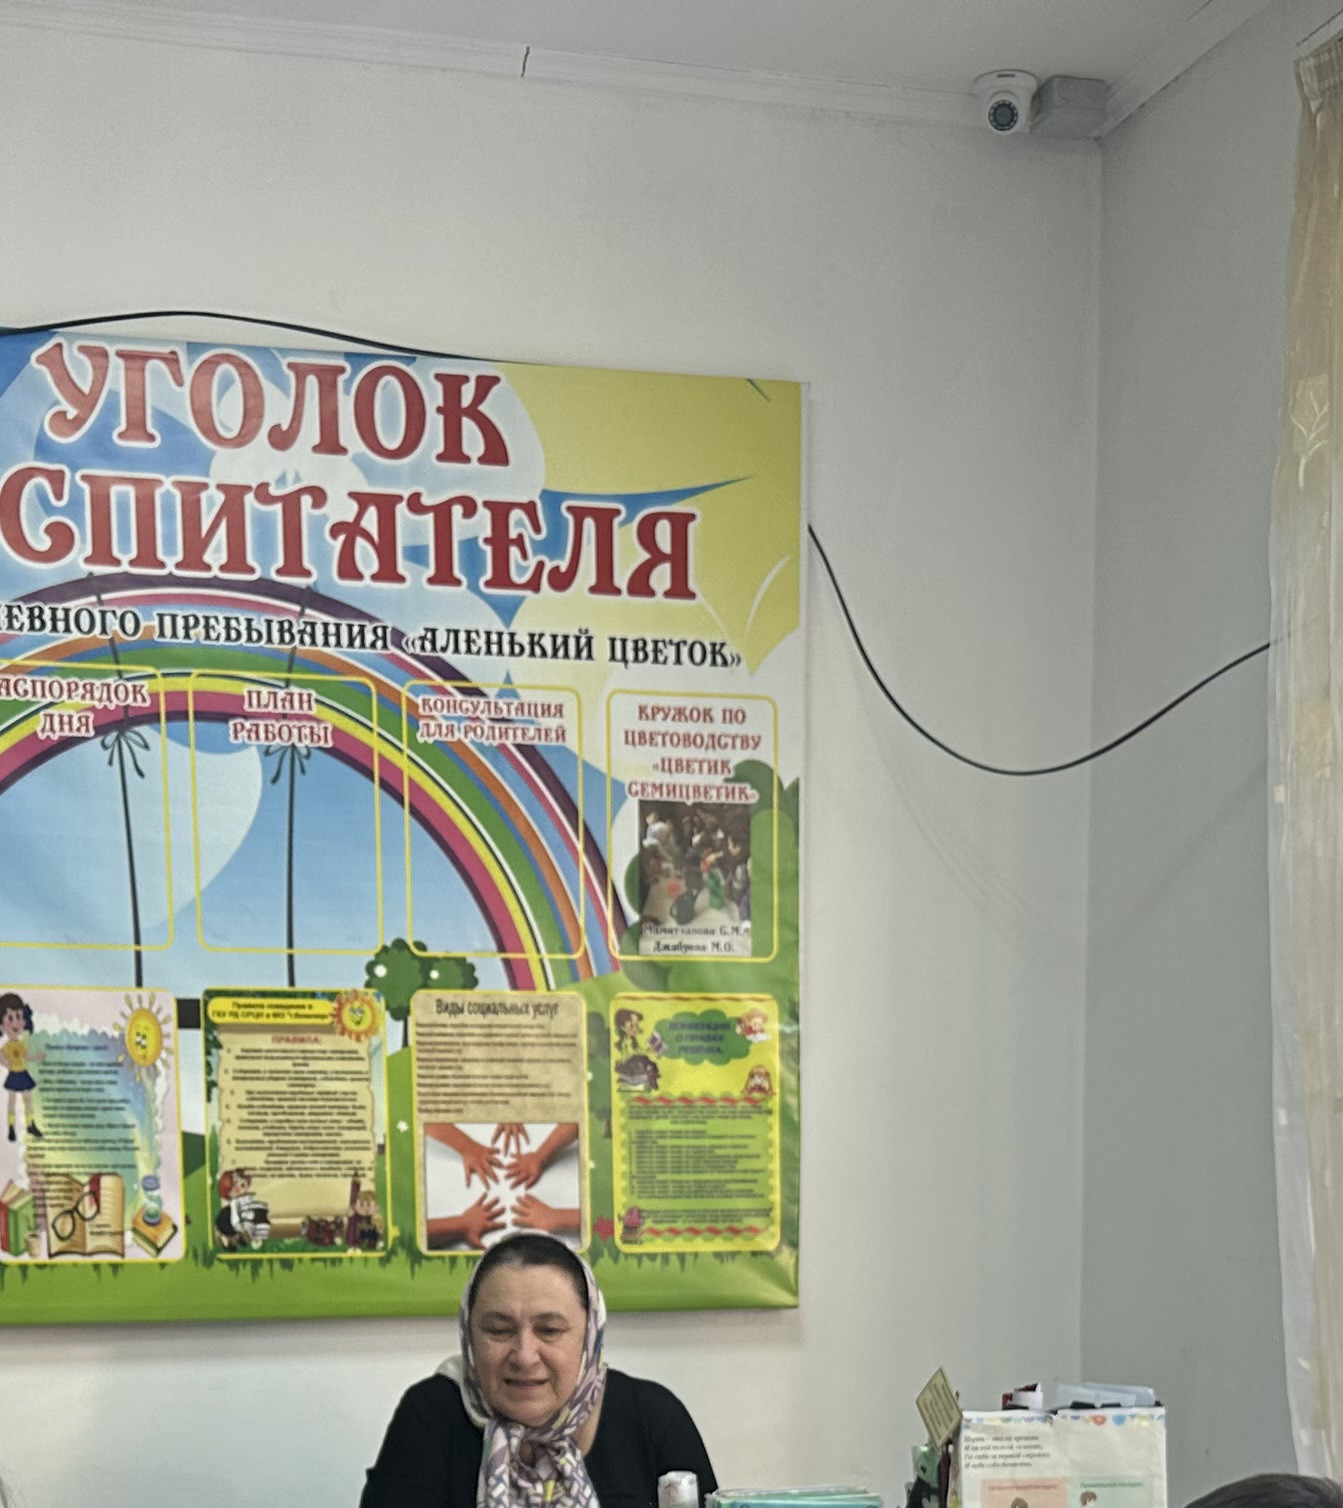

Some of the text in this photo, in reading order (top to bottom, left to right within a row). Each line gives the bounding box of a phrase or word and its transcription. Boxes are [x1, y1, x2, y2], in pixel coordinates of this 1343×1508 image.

[38, 341, 511, 466] УГОЛОК
[157, 613, 389, 651] ПРЕБЫВАНИЯ
[402, 627, 594, 662] «АЛЕНЬКИЙ
[608, 638, 742, 670] ЦВЕТОК»
[244, 690, 315, 712] ПЛАН
[421, 697, 564, 719] КОНСУЛЬТАЦИЯ
[38, 711, 94, 738] ДНЯ
[637, 704, 747, 725] КРУЖОК ПО
[231, 721, 332, 746] РАБОТЫ
[421, 722, 567, 743] ДЛЯ РОДИТЕЛЕЙ
[623, 729, 762, 752] ЦВЕТОВОДСТВУ
[435, 998, 465, 1019] Виды
